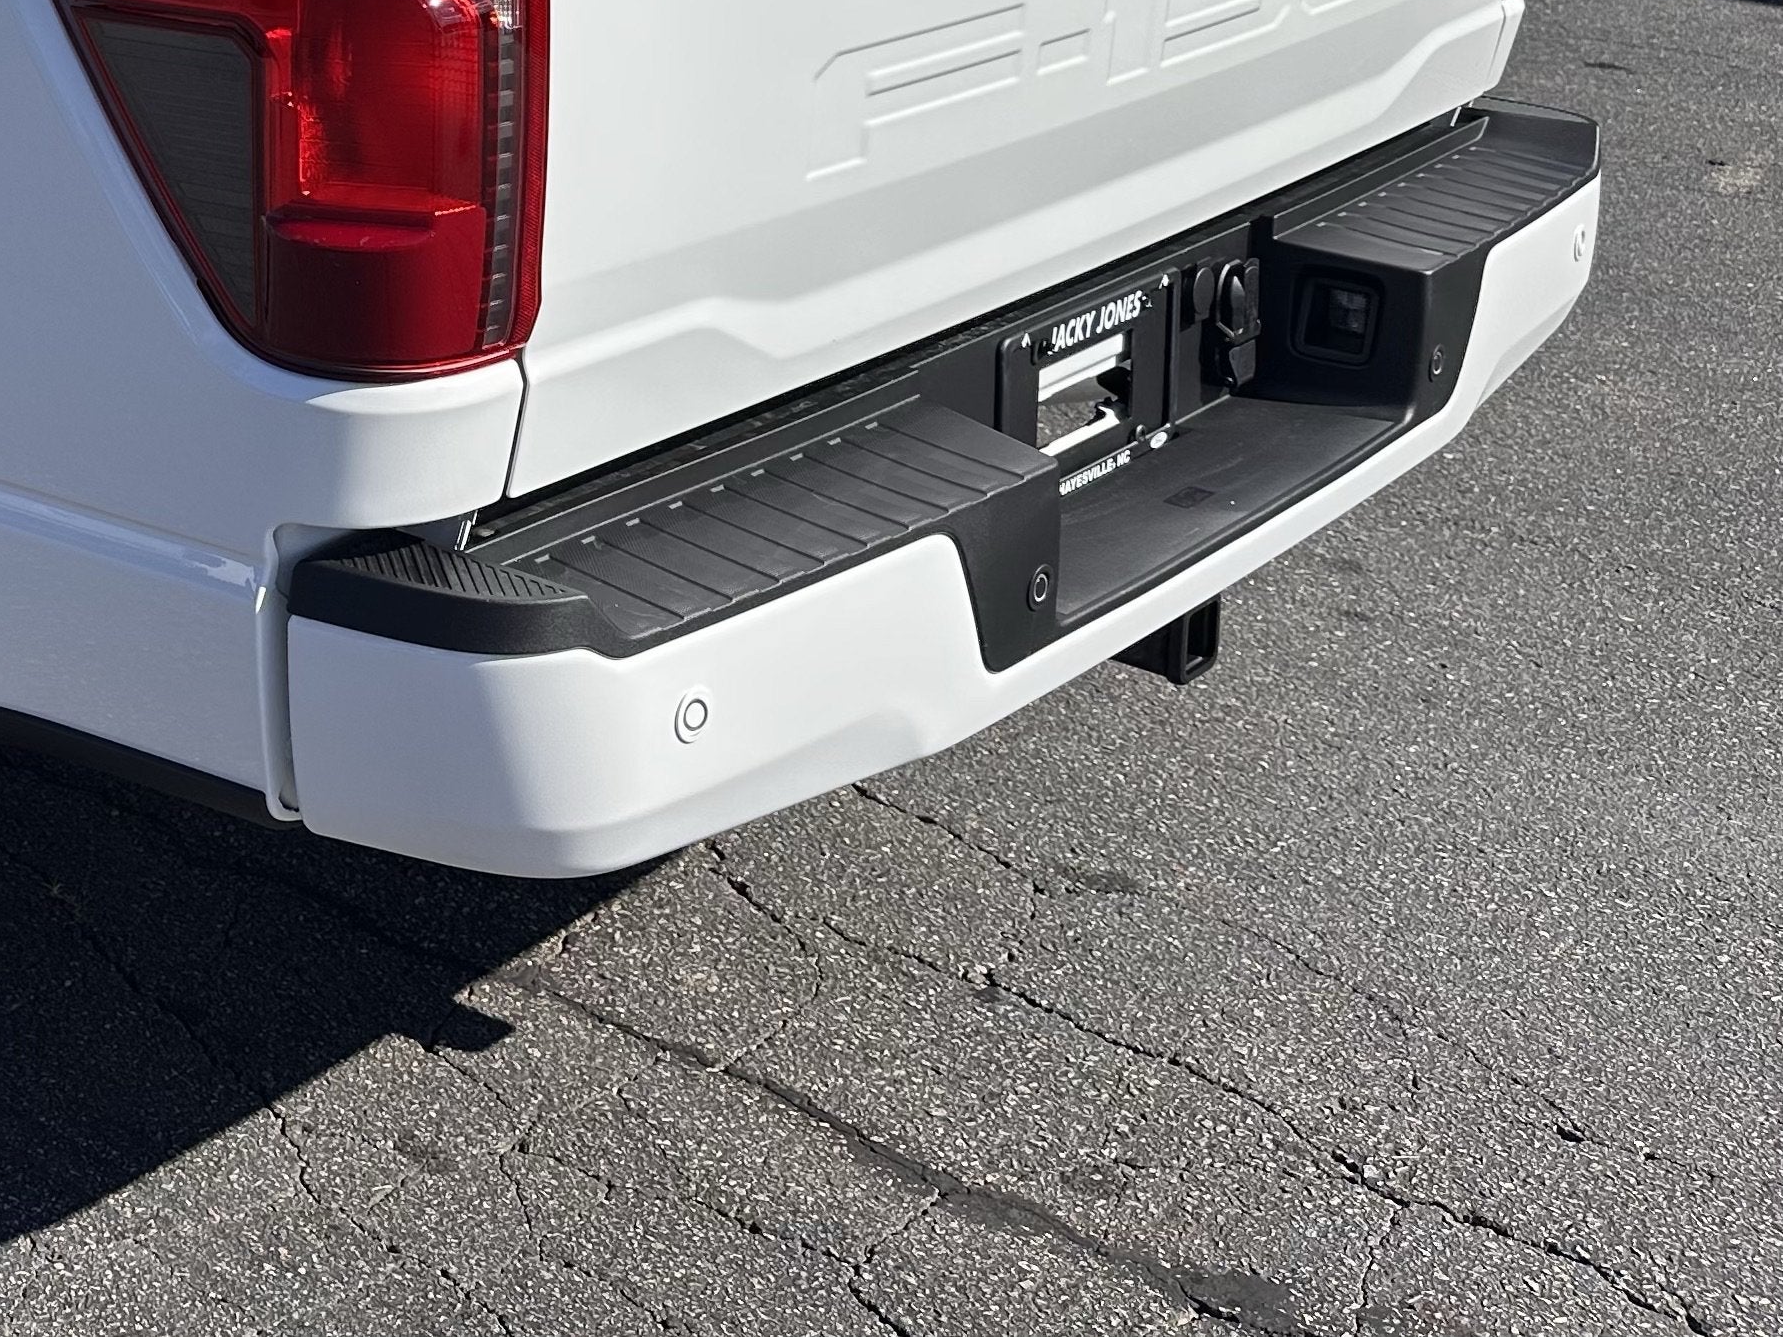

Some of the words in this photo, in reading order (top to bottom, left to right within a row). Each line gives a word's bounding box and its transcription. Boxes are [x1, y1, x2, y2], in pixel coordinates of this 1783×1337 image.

[1051, 310, 1097, 353] JACKY
[1096, 290, 1143, 334] JONES
[1117, 449, 1131, 467] NC
